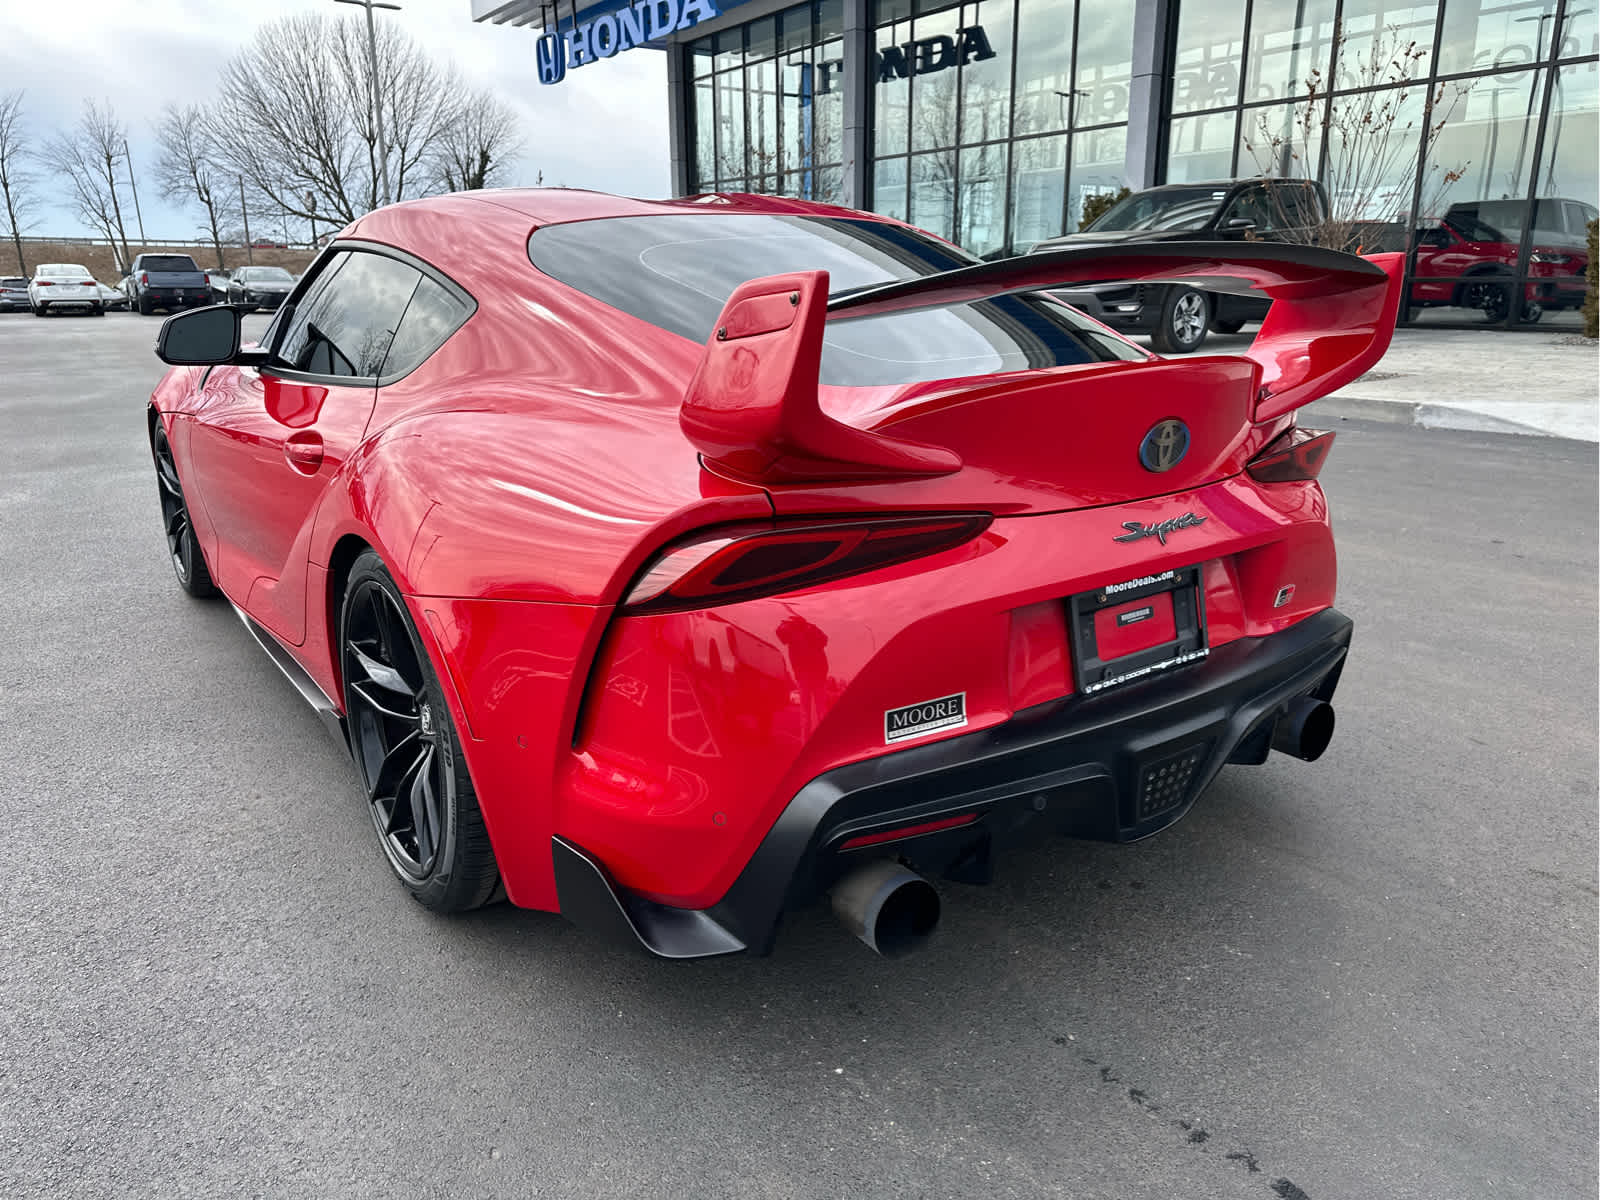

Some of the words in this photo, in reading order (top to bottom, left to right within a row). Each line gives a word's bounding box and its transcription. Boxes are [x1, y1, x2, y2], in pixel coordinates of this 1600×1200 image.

[565, 0, 721, 69] HONDA
[1112, 512, 1208, 546] Supra
[1105, 570, 1174, 595] MooreDeals.com
[893, 699, 959, 729] MOORE
